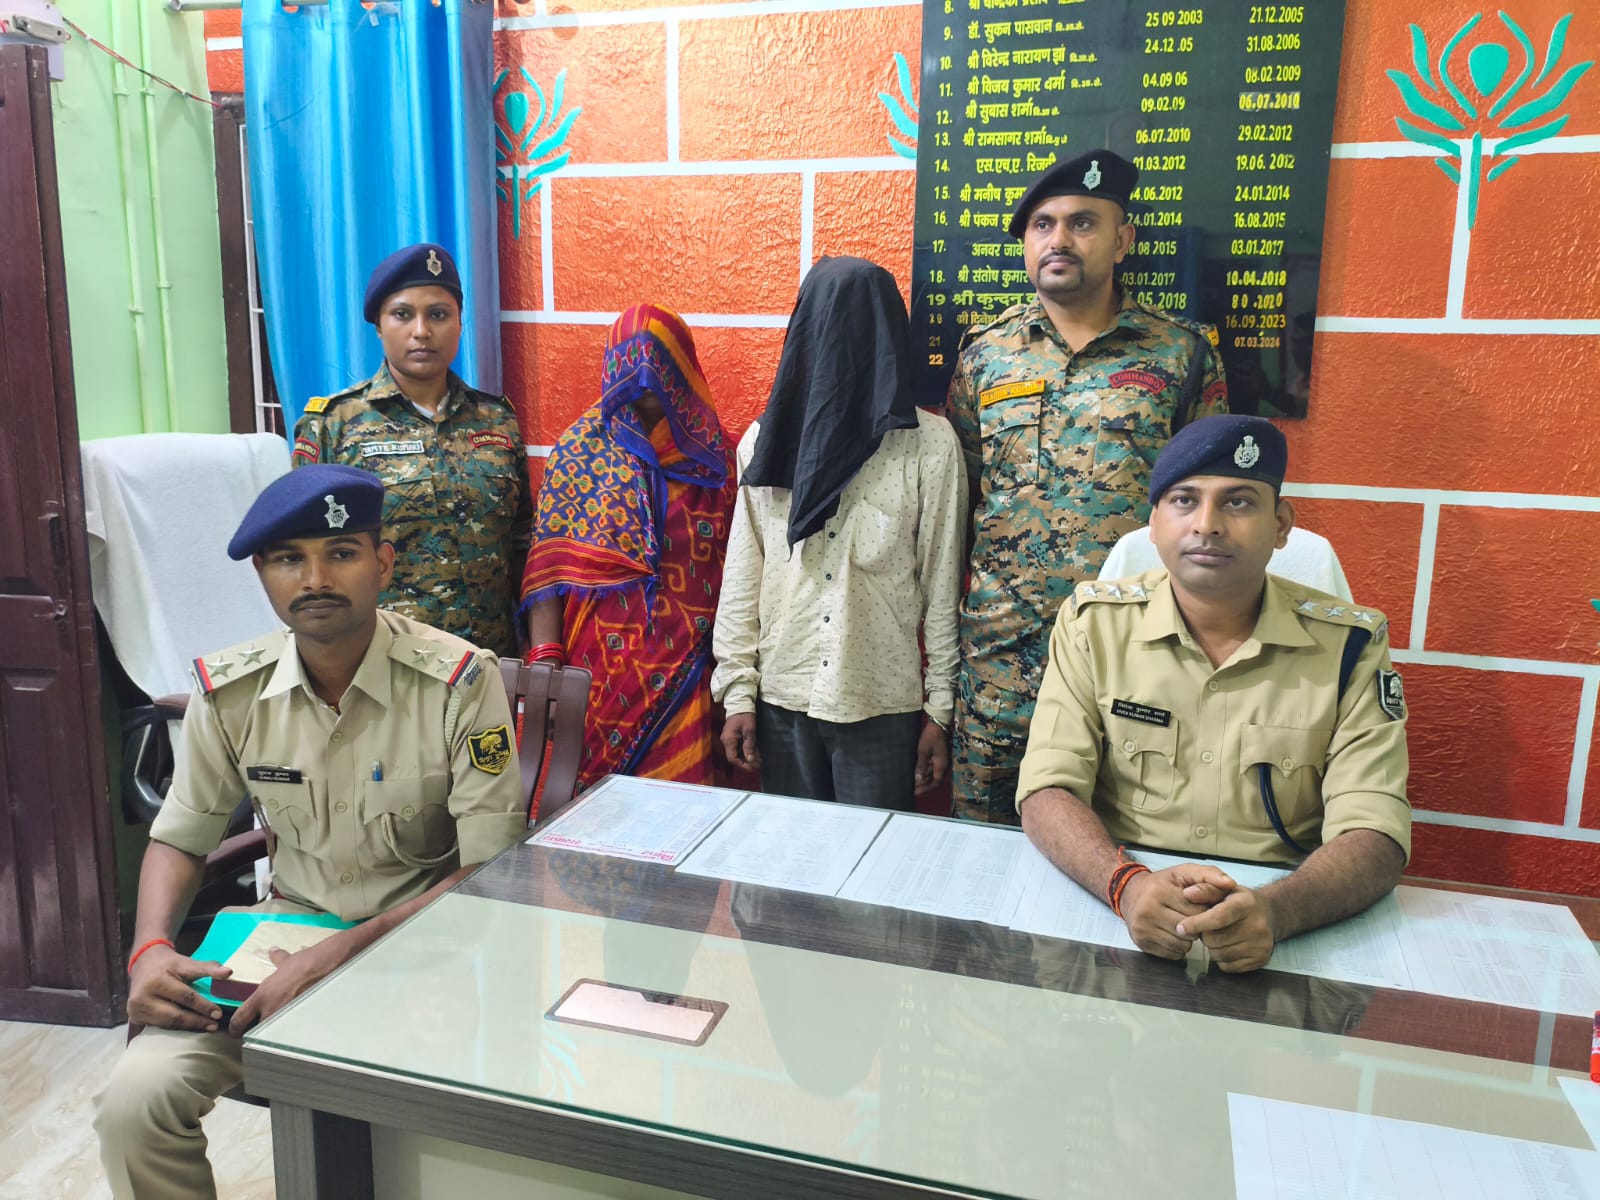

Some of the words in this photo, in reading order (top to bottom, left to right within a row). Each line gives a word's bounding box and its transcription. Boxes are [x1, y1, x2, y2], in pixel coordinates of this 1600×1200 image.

[1145, 12, 1158, 28] 25
[1161, 11, 1174, 26] 09
[1177, 9, 1202, 26] 2003
[1248, 6, 1304, 24] 21.12.2005
[943, 27, 954, 41] 9.
[1014, 19, 1053, 34] पासवान
[1246, 34, 1301, 53] 31.08.2006
[967, 50, 979, 69] श्री
[1012, 48, 1050, 65] नारायण
[1174, 71, 1188, 87] 06
[1245, 65, 1301, 84] 08.02.2009
[939, 83, 953, 97] 11.
[967, 76, 979, 95] श्री
[981, 75, 1009, 95] विजय
[1012, 78, 1041, 98] कुमार
[1140, 96, 1186, 112] 09.02.09
[1239, 93, 1300, 110] 06.07.2010
[936, 110, 952, 125] 12.
[965, 99, 977, 119] श्री
[934, 132, 950, 147] 13.
[962, 128, 975, 146] श्री
[977, 132, 1022, 147] रामसागर
[1135, 128, 1191, 144] 06.07.2010
[1237, 124, 1293, 142] 29.02.2012
[934, 159, 950, 173] 14.
[1269, 154, 1296, 170] 2012
[934, 185, 950, 200] 15.
[960, 183, 971, 203] श्री
[973, 182, 1001, 202] मनीष
[1004, 187, 1027, 206] कुम
[1234, 185, 1290, 202] 24.01.2014
[959, 209, 970, 228] श्री
[973, 211, 999, 229] पंकज
[1126, 211, 1183, 228] 24.01.2014
[1234, 212, 1287, 229] 16.08.2015
[932, 240, 946, 254] 17.
[971, 243, 1001, 258] अनवर
[1137, 242, 1150, 256] 08
[1152, 241, 1177, 256] 2015
[1231, 240, 1284, 257] 03.01.2017
[956, 265, 969, 284] श्री
[972, 265, 999, 285] संतोष
[1226, 271, 1287, 287] 10.04.2018
[926, 294, 945, 306] 19
[952, 290, 973, 306] श्री
[1225, 314, 1287, 330] 16.09.2023
[928, 353, 944, 366] 22
[1112, 371, 1162, 390] COMMANDO
